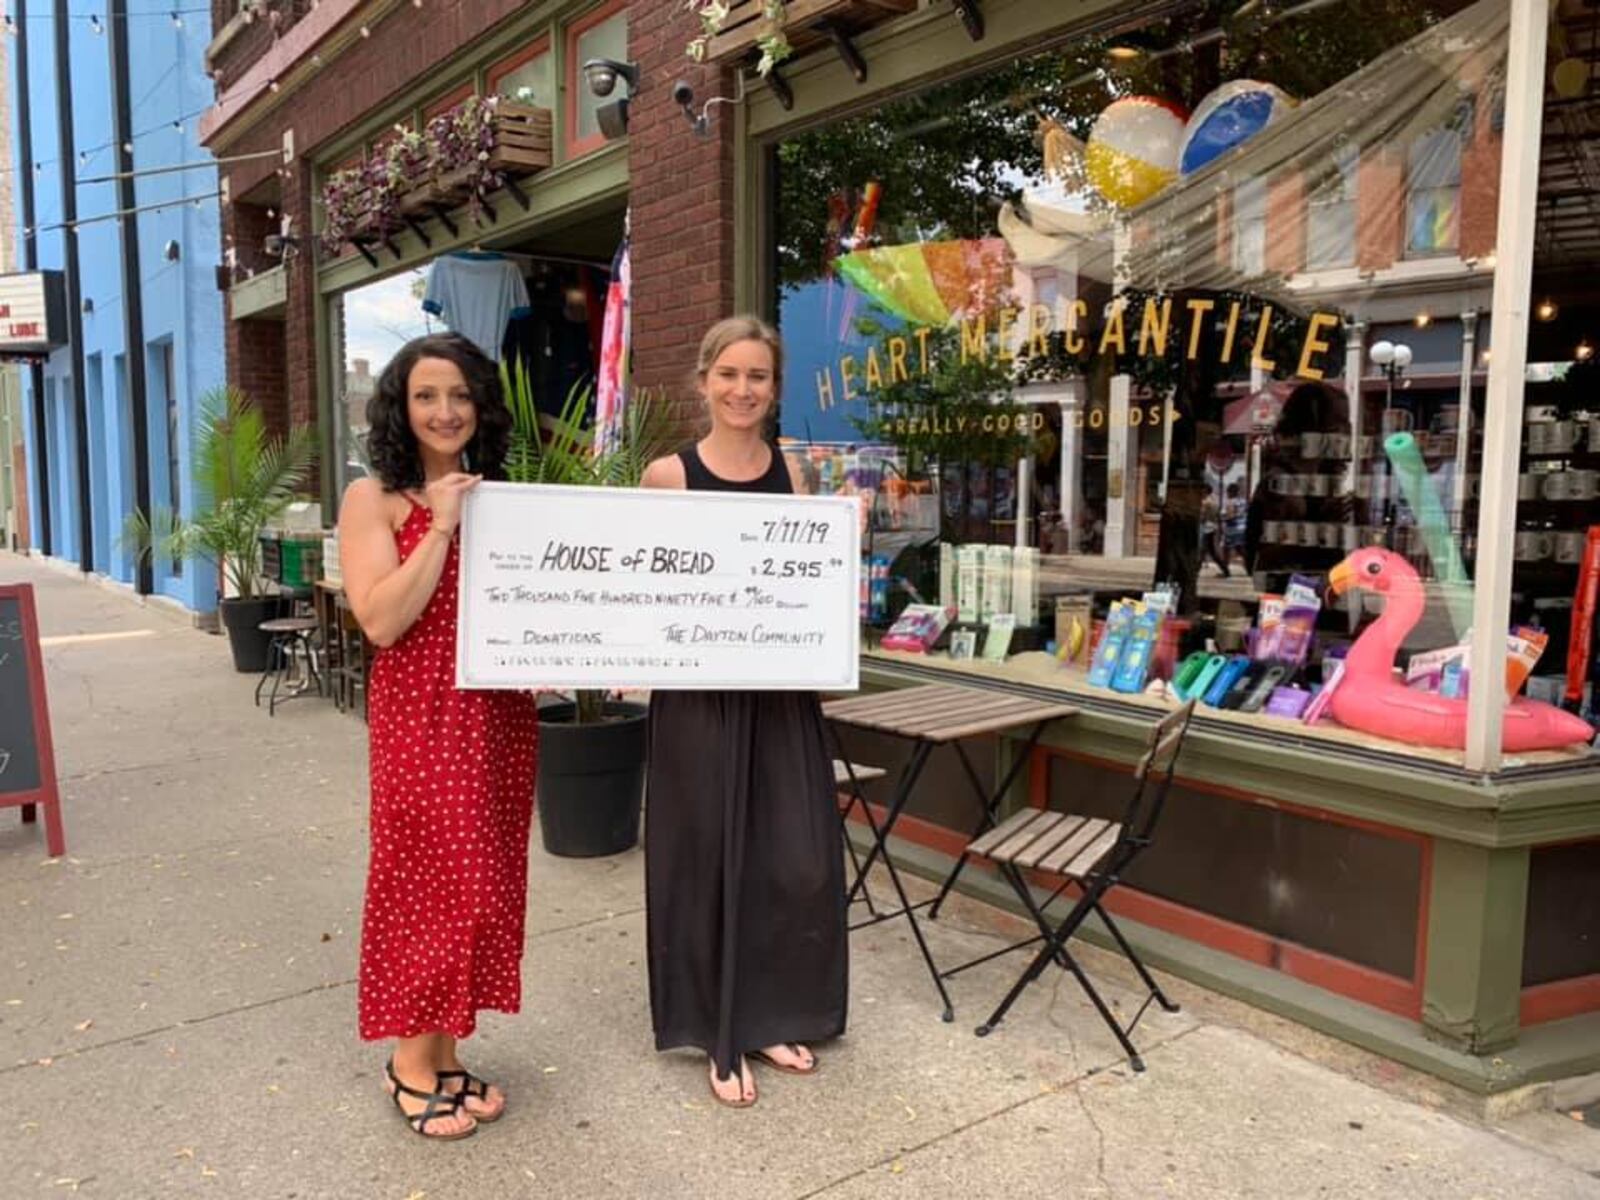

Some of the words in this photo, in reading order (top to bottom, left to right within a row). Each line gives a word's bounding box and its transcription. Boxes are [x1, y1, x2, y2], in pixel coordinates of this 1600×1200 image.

[816, 327, 930, 412] HEART
[959, 299, 1338, 380] MERCANTILE
[896, 416, 966, 434] REALLY
[982, 412, 1044, 433] GOOD
[762, 519, 830, 544] 7/11/19
[539, 540, 613, 571] HOUSE
[620, 548, 646, 571] of
[650, 547, 715, 575] BREAD
[761, 558, 823, 579] 2,595
[690, 624, 749, 643] DAYTON
[751, 623, 826, 646] COMMUNITY
